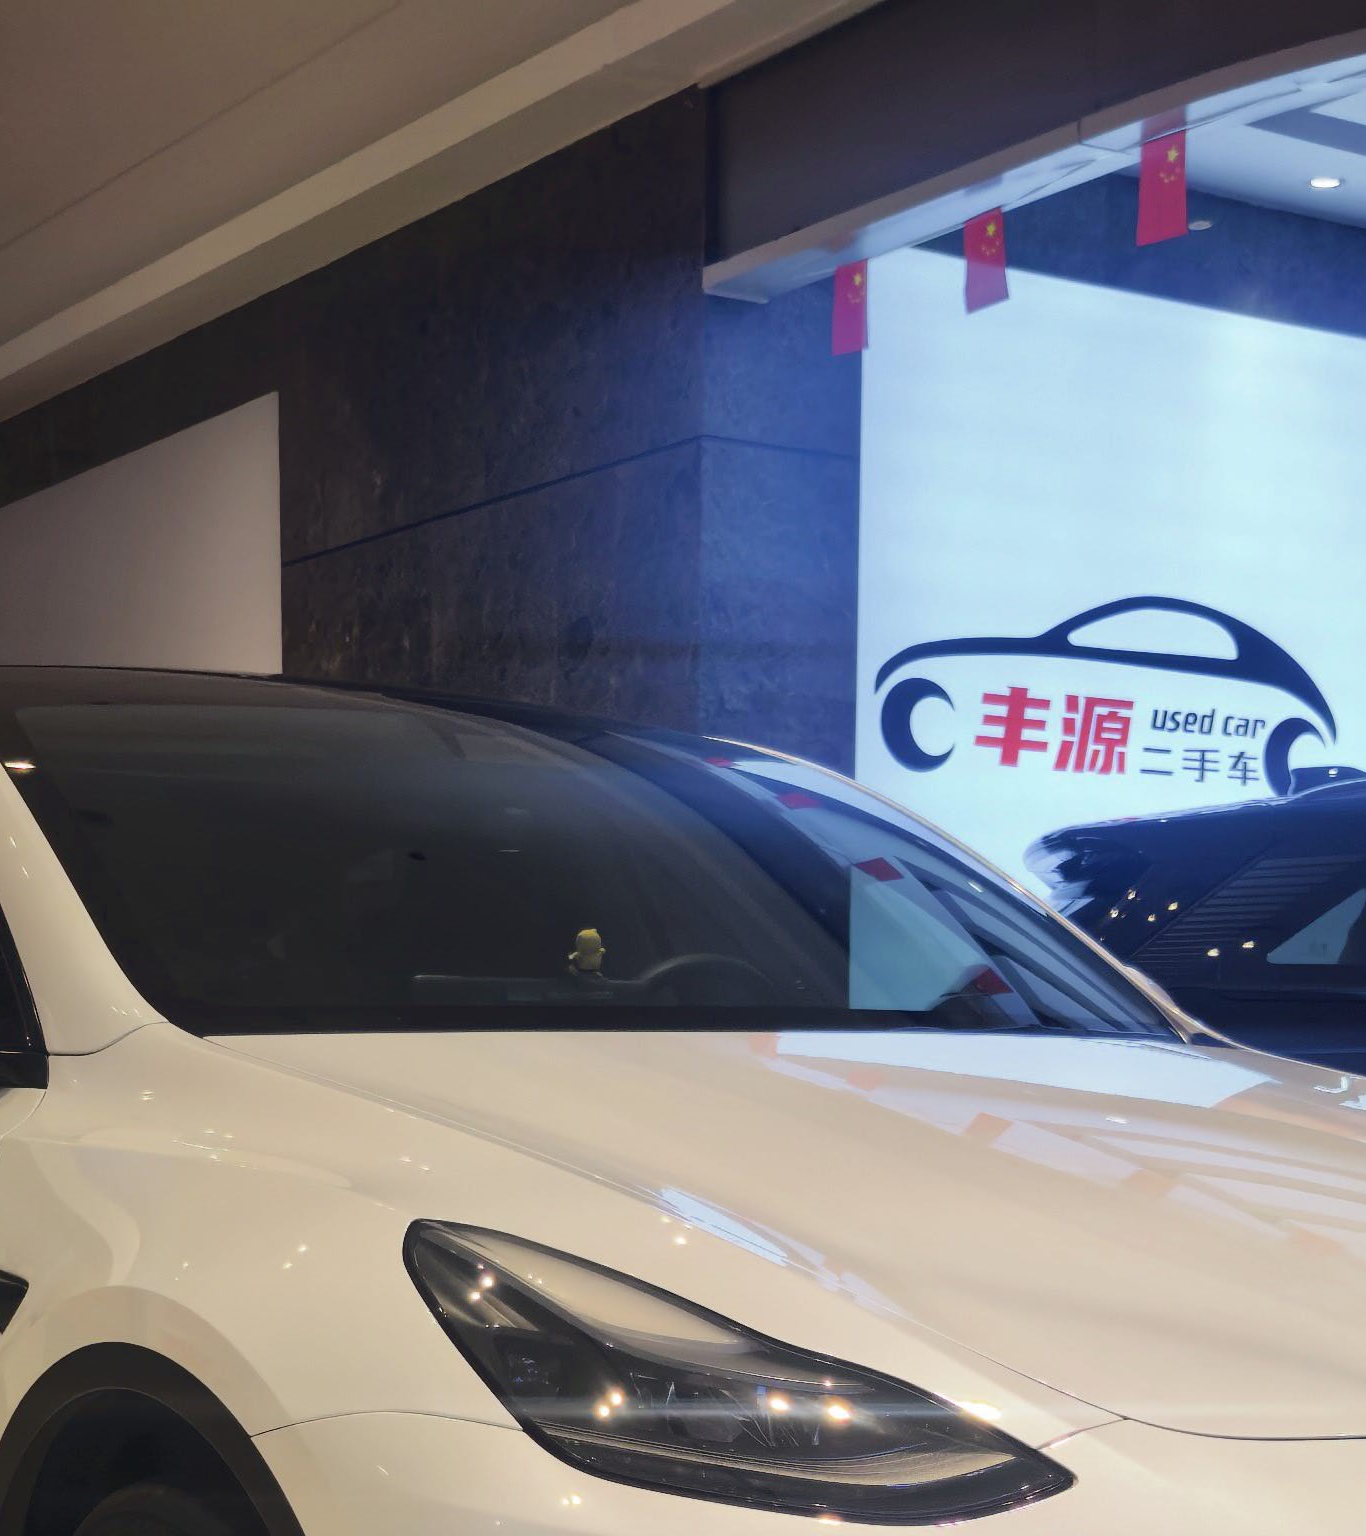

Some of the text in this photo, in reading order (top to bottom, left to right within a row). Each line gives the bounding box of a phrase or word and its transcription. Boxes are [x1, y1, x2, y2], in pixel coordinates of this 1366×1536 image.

[974, 686, 1135, 776] 丰源
[1151, 707, 1265, 738] used car
[1139, 747, 1260, 786] 二手车
